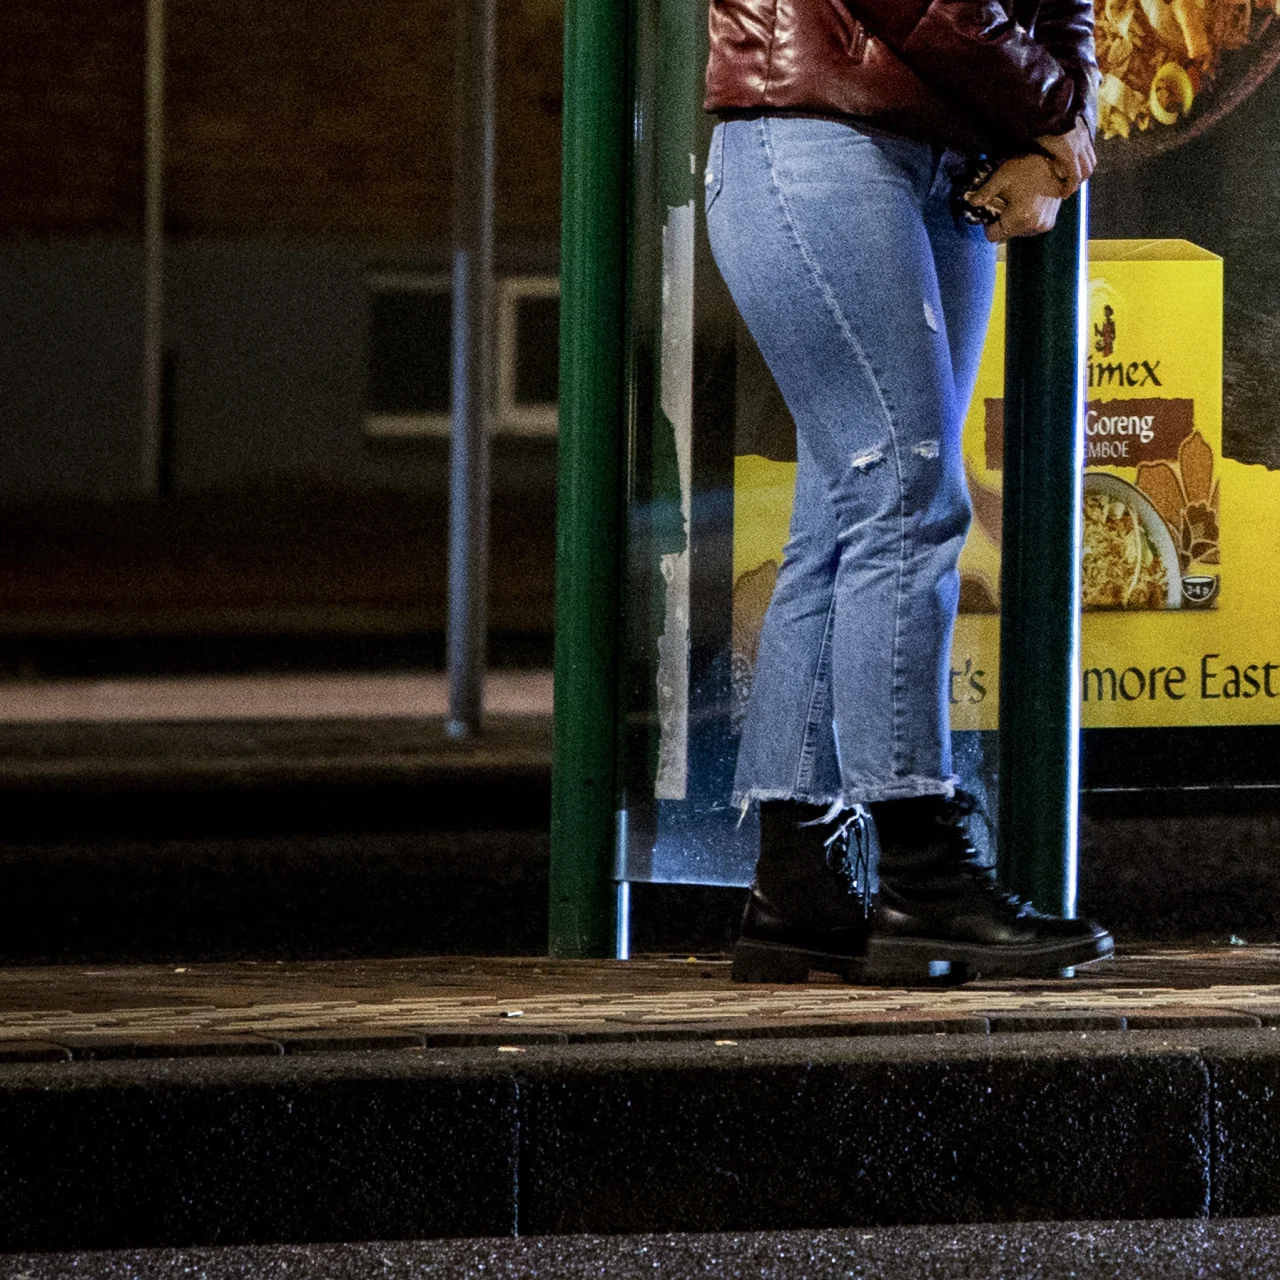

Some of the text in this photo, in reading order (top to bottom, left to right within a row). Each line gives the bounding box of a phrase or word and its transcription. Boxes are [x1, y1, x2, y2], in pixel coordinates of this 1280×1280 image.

[1087, 355, 1163, 388] imex
[1084, 410, 1155, 444] Goreng
[1082, 665, 1186, 702] more
[1200, 654, 1280, 700] East
